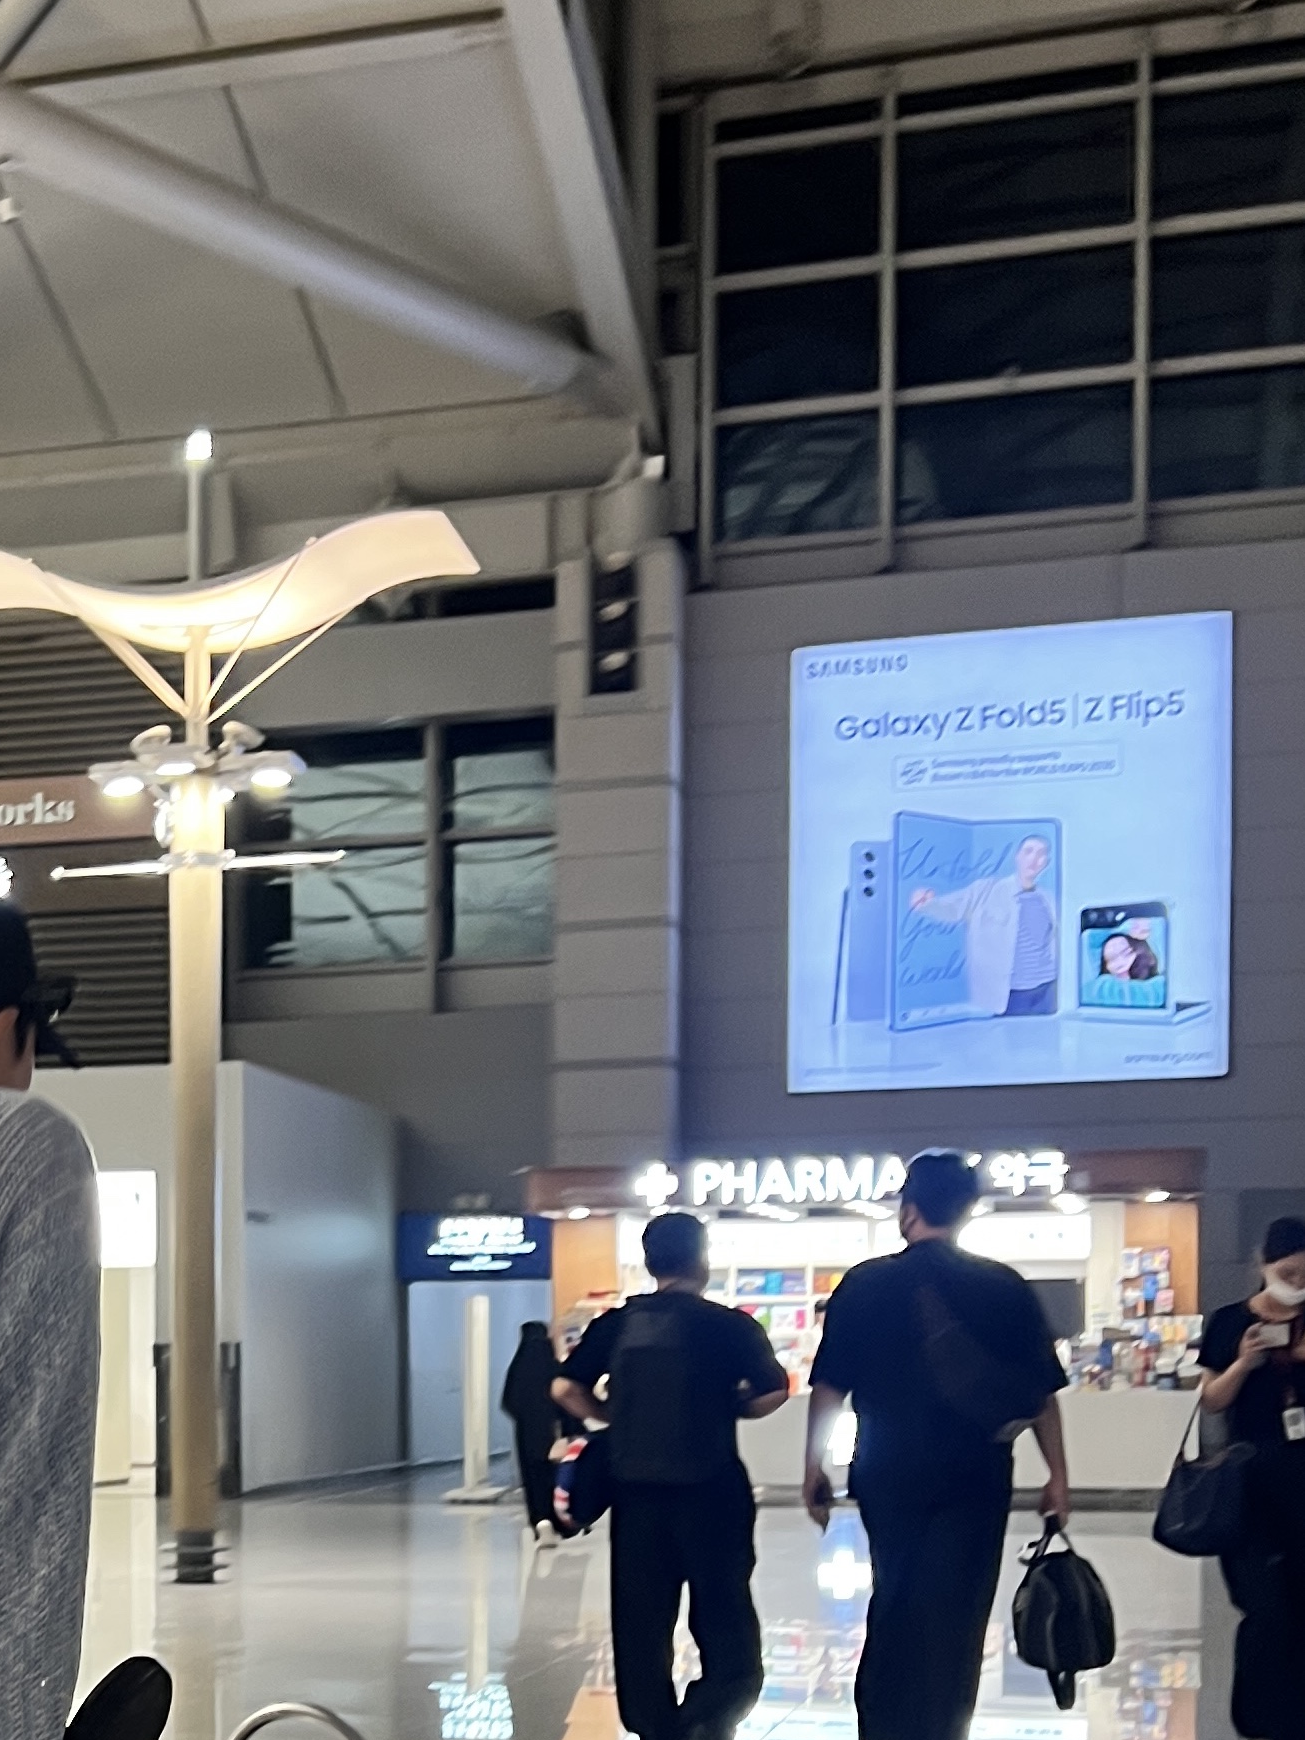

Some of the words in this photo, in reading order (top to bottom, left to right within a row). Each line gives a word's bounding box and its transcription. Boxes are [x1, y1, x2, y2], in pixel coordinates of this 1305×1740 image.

[806, 654, 908, 679] SAMSUNG
[834, 710, 952, 741] Galaxy
[955, 705, 976, 733] Z
[978, 698, 1067, 732] Fold5
[1083, 695, 1104, 723] Z
[1109, 689, 1185, 727] Flip5
[694, 1152, 982, 1206] PHARMA
[989, 1151, 1069, 1196] 약국
